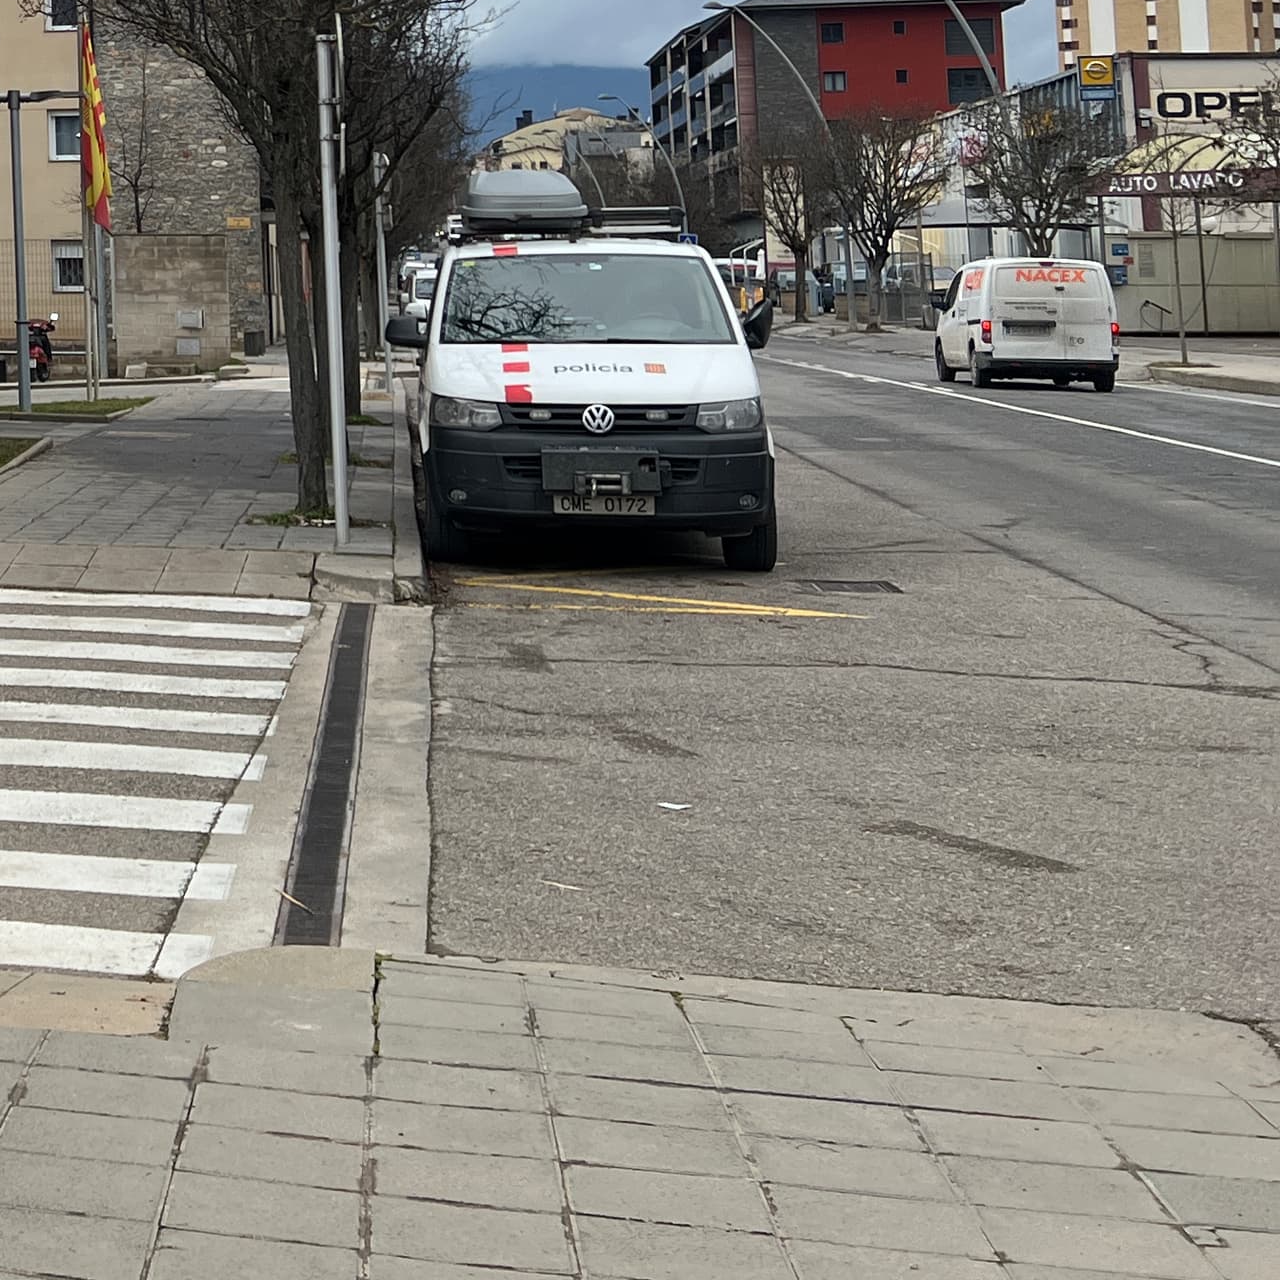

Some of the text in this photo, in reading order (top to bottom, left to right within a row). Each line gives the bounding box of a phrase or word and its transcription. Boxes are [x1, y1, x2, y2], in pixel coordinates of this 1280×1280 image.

[1109, 175, 1158, 192] AUTO
[1015, 269, 1087, 283] NACEX
[553, 362, 633, 374] policia
[560, 496, 648, 513] CME 0172
